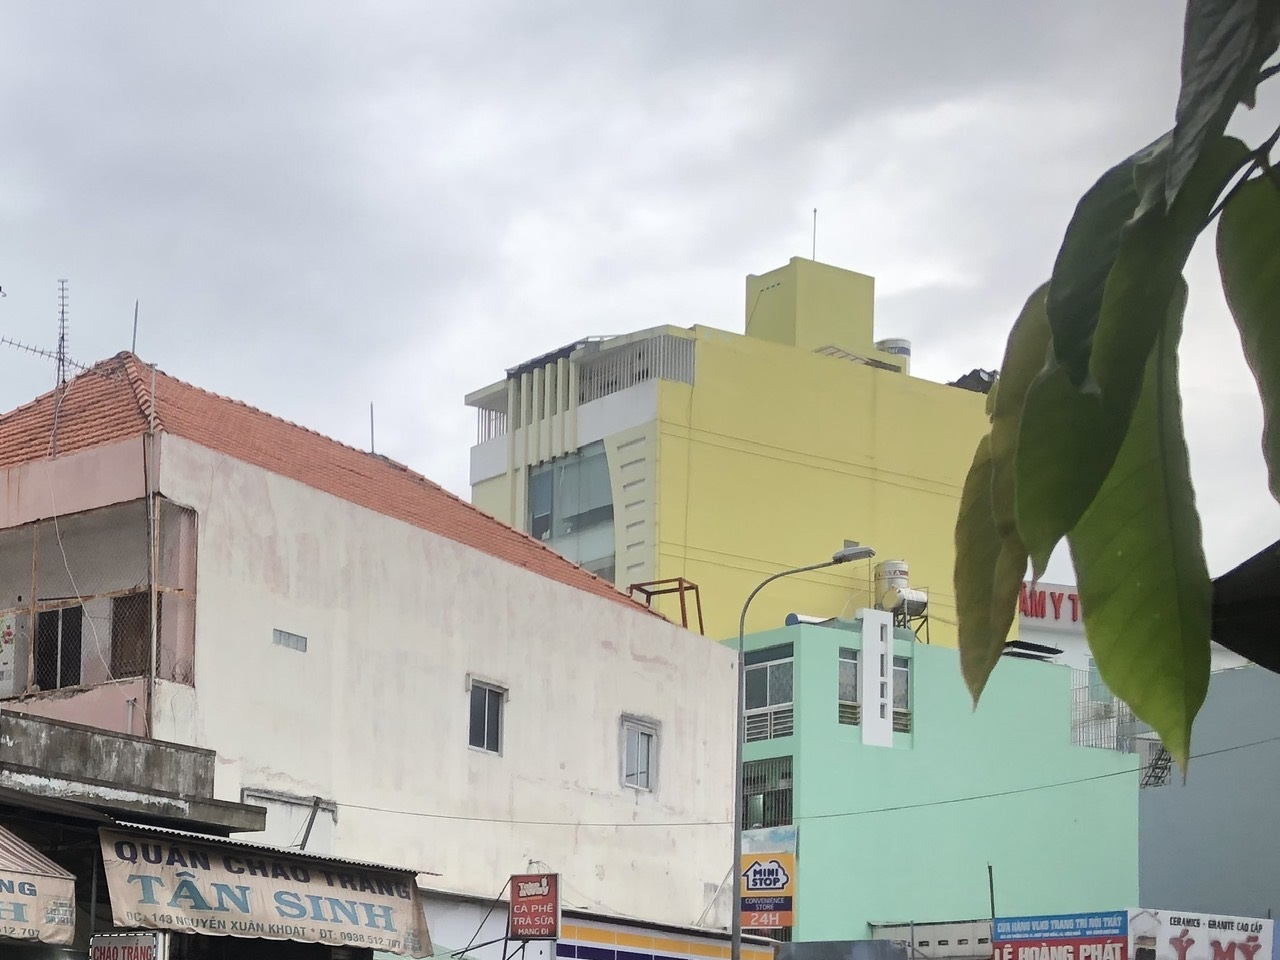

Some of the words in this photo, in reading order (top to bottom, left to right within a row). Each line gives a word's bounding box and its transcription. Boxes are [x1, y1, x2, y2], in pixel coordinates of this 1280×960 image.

[753, 868, 779, 878] MINI
[752, 877, 780, 887] STOP
[126, 870, 251, 914] TÂN
[273, 890, 397, 932] SINH
[513, 903, 528, 913] CÀ
[531, 902, 554, 913] PHÊ
[513, 915, 532, 925] TRÀ
[534, 914, 555, 925] SỮA
[751, 912, 780, 926] 24H
[1169, 917, 1201, 928] CERAMICS
[1208, 920, 1234, 931] GRANITE
[1236, 922, 1249, 933] CAO
[1250, 920, 1263, 933] CẤP
[152, 912, 173, 924] 143
[176, 915, 226, 929] NGUYỄN
[231, 920, 264, 933] XUÂN
[269, 922, 306, 937] KHOÁT
[320, 928, 337, 940] ĐT:
